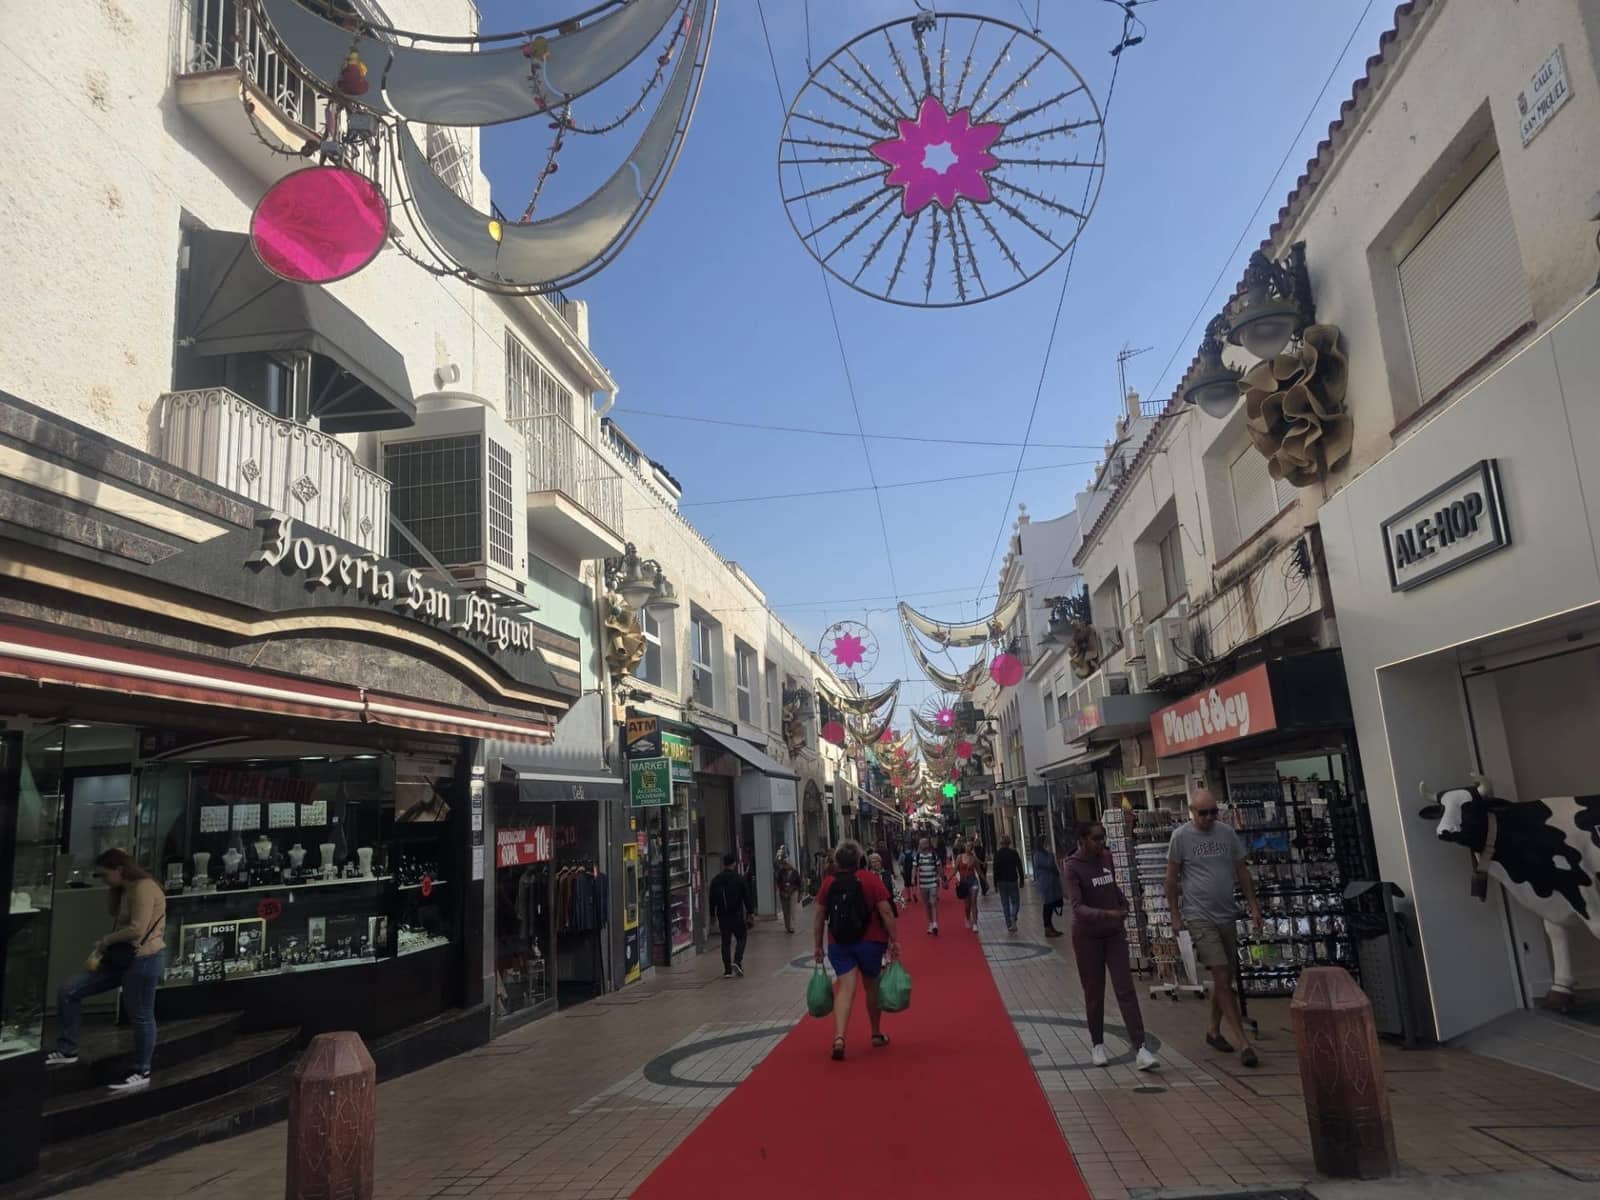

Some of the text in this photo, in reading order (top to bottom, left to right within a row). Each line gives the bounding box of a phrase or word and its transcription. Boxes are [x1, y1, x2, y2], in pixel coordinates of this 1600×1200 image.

[1534, 63, 1553, 92] CALLE
[1523, 79, 1567, 134] SAN MIGUEL
[1395, 492, 1483, 569] ALE-HOP
[406, 568, 451, 622] San
[462, 590, 535, 651] Miguel
[628, 719, 656, 732] ATM
[631, 760, 667, 771] MARKET
[212, 925, 235, 934] BOSS
[197, 973, 222, 982] BOSS
